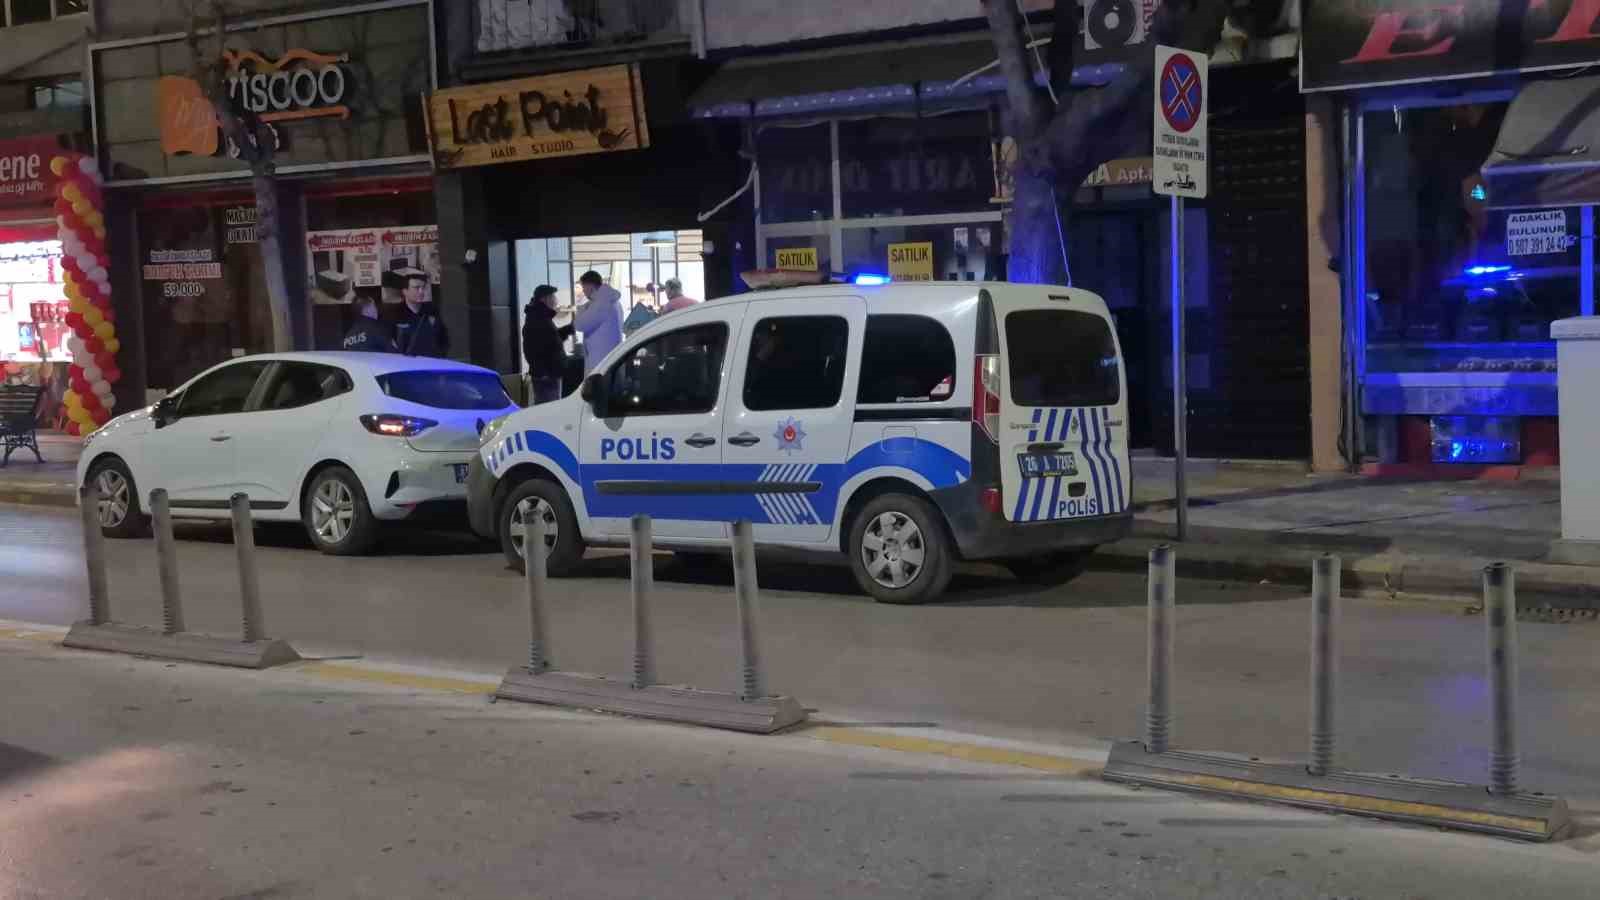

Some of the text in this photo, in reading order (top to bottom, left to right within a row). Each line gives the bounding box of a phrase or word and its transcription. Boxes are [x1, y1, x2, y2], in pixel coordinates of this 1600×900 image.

[520, 83, 609, 137] Point
[490, 140, 574, 159] HAIR STUDIO
[1511, 212, 1561, 223] ADAKLIK
[1508, 225, 1565, 236] BULUNUR
[1508, 239, 1514, 254] 0
[778, 252, 815, 267] SATILIK
[891, 247, 929, 265] SATILIK
[600, 431, 676, 461] POLİS
[1025, 455, 1038, 472] 26
[1059, 494, 1097, 517] POLİS
